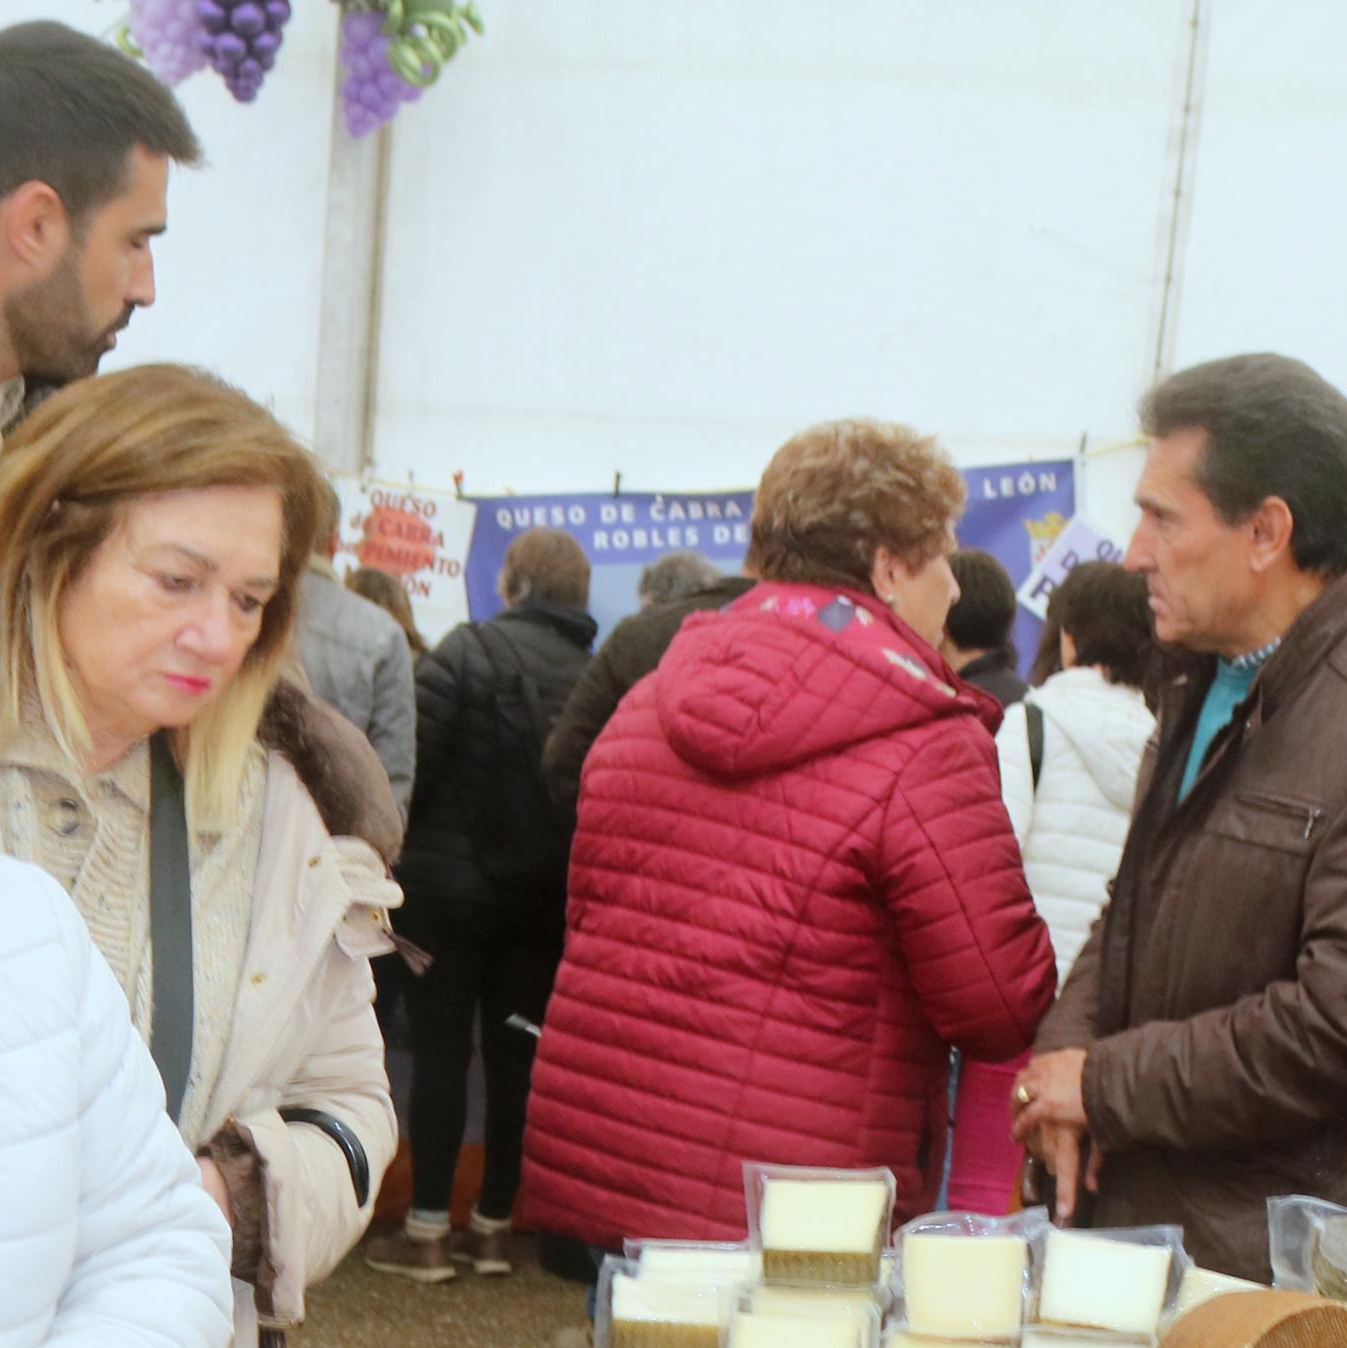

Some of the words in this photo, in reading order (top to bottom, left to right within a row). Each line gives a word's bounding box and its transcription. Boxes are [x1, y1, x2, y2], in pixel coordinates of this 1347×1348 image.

[371, 490, 437, 518] QUESO
[496, 504, 586, 530] QUESO
[602, 502, 636, 523] DE
[650, 499, 742, 522] CABRA
[378, 517, 445, 548] CABRA
[593, 525, 700, 550] ROBLES
[713, 522, 750, 545] DE
